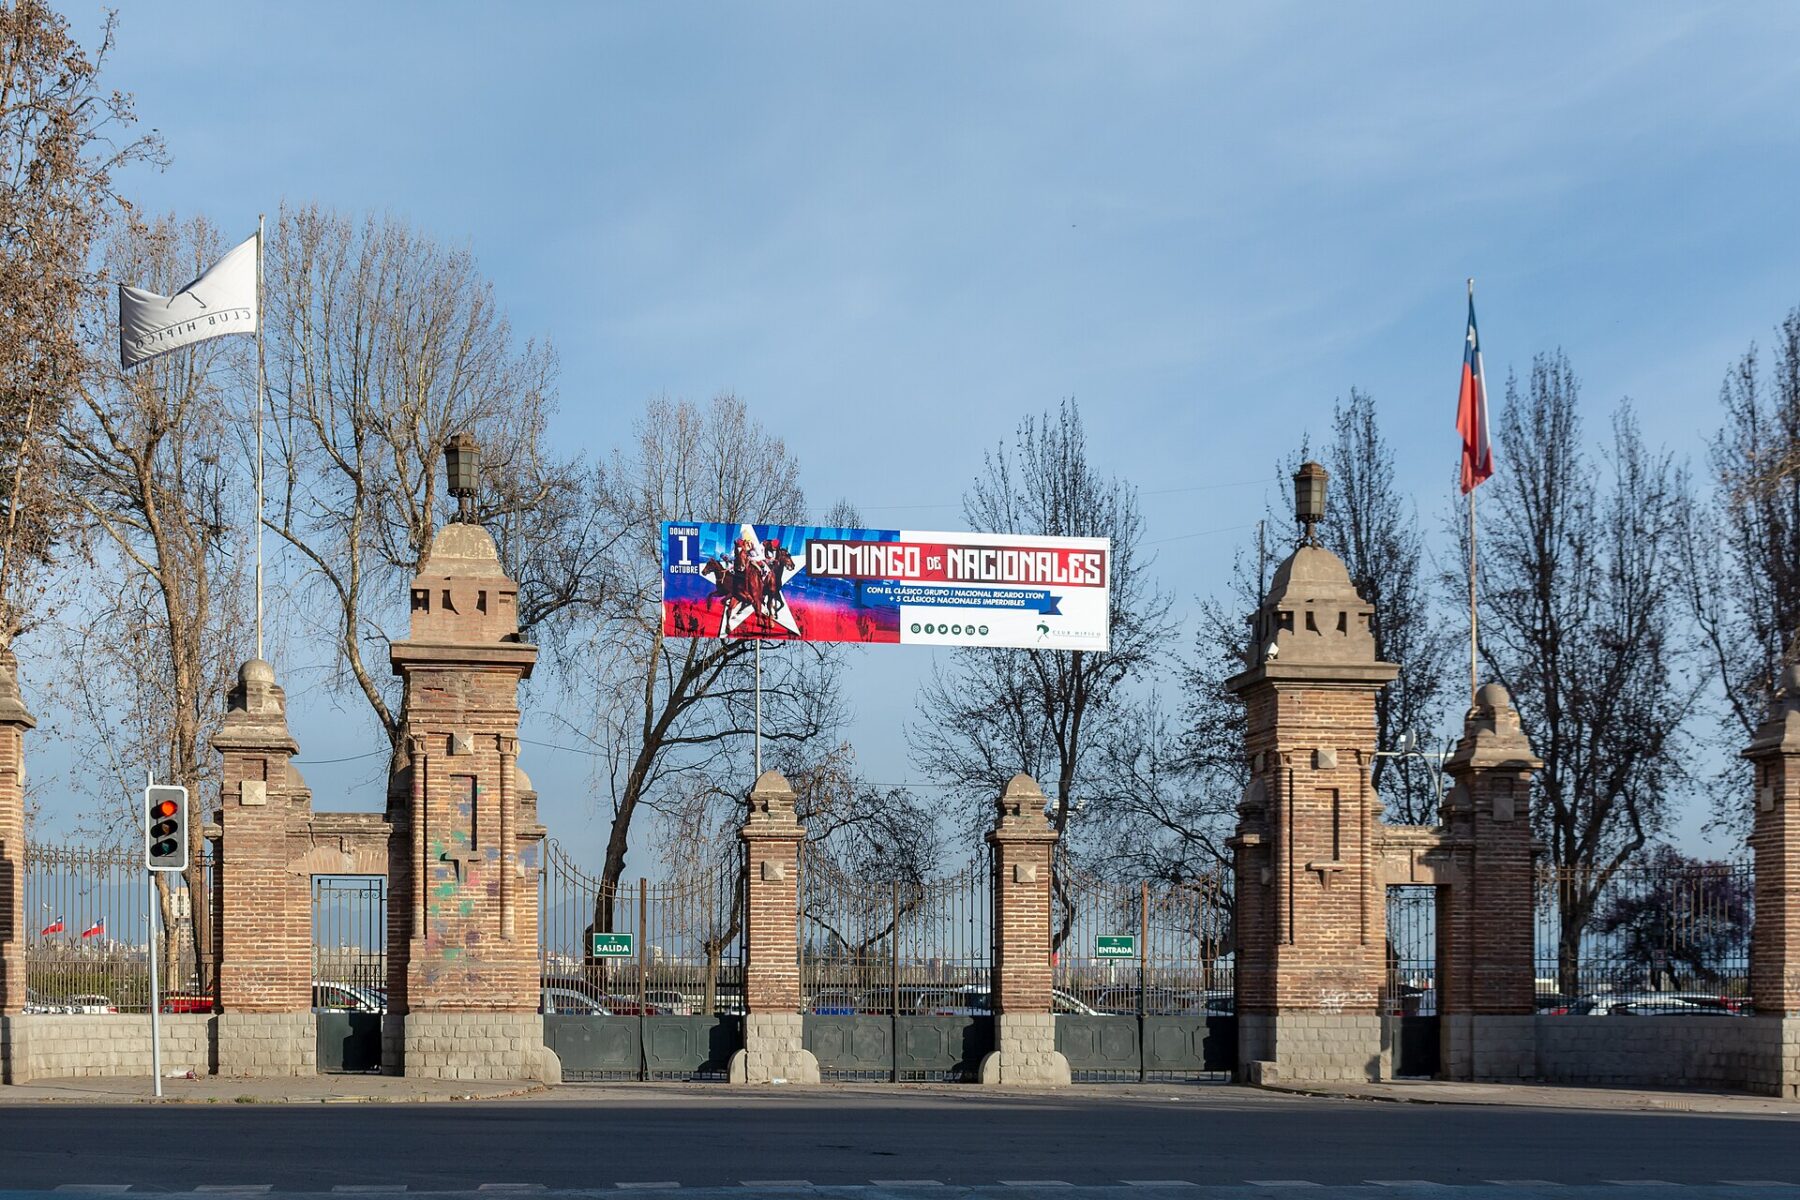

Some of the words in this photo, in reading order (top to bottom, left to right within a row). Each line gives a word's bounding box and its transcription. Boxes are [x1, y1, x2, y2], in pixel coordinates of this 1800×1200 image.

[669, 527, 699, 536] DOMINGO
[678, 536, 692, 566] 1
[811, 543, 921, 577] DOMINGO
[926, 556, 942, 571] DE
[947, 548, 1101, 585] NACIONALES
[670, 565, 699, 574] OCTUBRE
[893, 586, 922, 595] CLÁSICO
[902, 594, 936, 603] CLÁSICOS
[937, 596, 981, 605] NACIONALES
[982, 598, 1025, 606] IMPERDIBLES
[596, 944, 629, 952] SALIDA
[1098, 946, 1133, 954] ENTRADA
